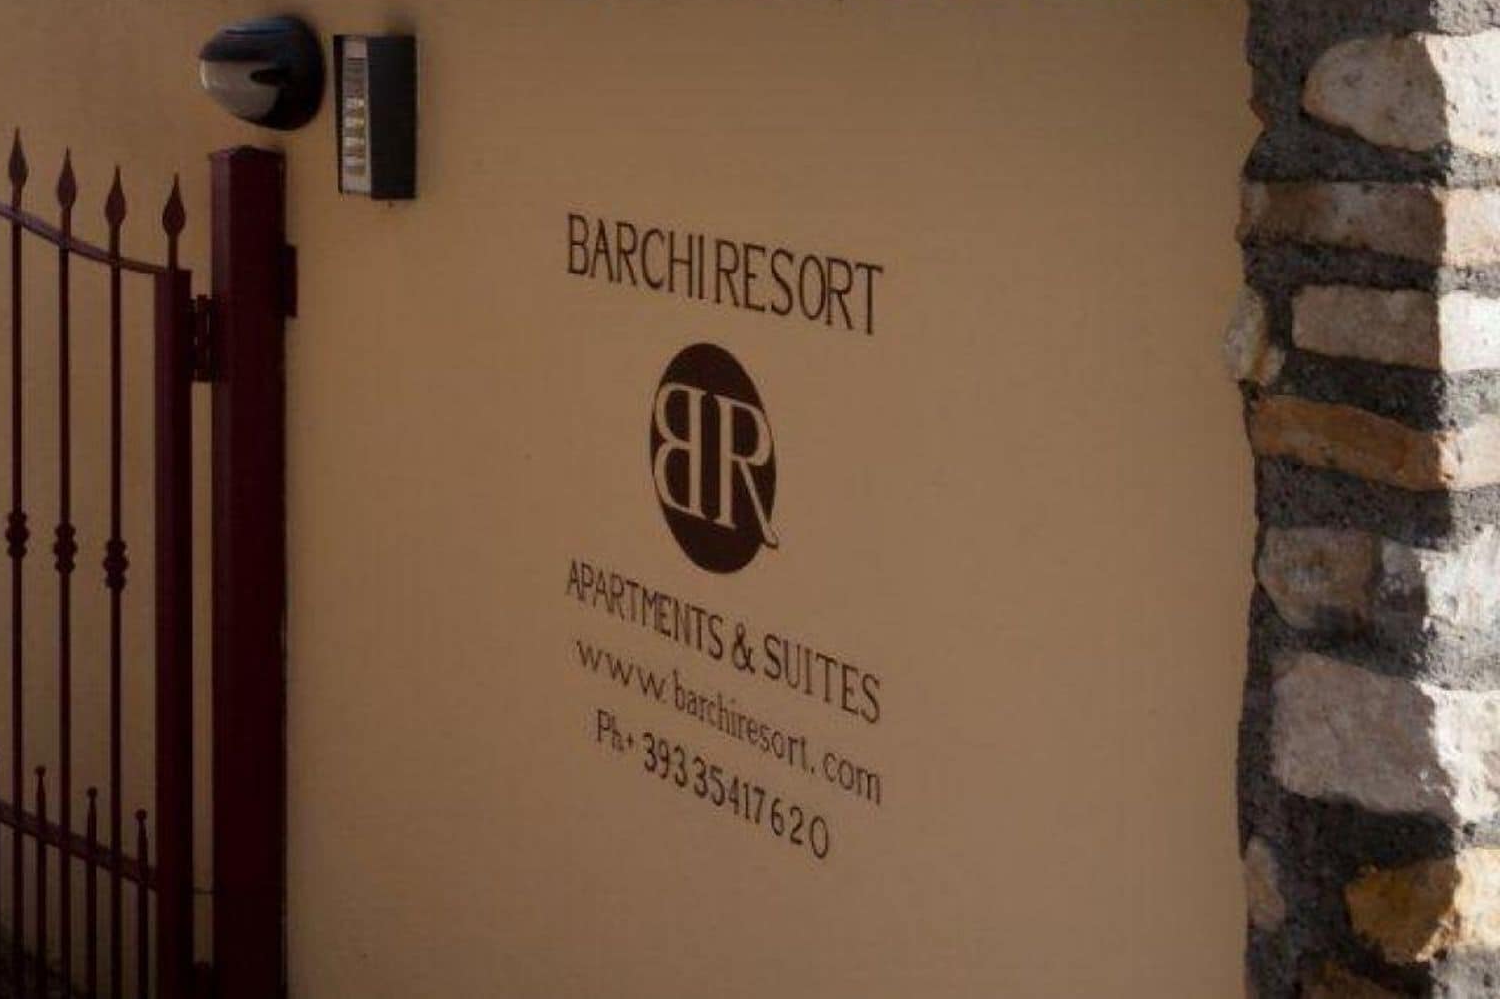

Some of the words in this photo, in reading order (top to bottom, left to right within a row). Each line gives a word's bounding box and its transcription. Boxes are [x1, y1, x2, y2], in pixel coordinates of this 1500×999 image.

[567, 212, 884, 335] BARCHIRESORT
[566, 559, 724, 661] APARTMENTS
[732, 621, 756, 674] &
[763, 632, 881, 724] SUITES
